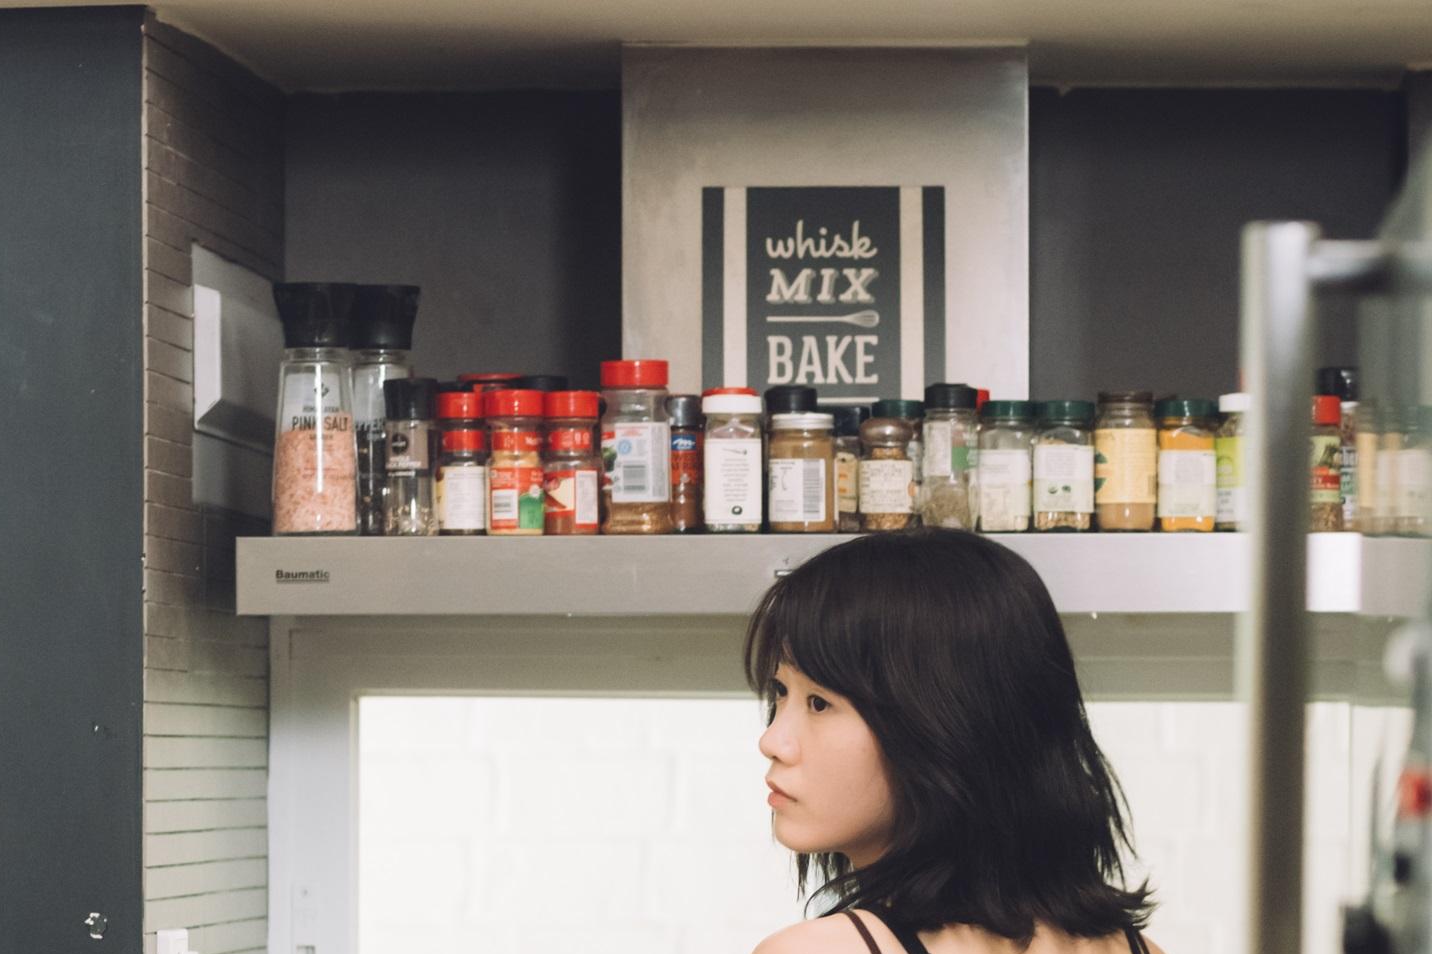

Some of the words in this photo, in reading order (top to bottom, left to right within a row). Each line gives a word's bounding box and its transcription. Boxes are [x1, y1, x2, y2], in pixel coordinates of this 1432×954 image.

[765, 219, 878, 260] whisk
[766, 267, 879, 304] MIX
[766, 334, 879, 385] BAKE
[324, 416, 349, 432] SALT
[274, 568, 330, 580] Baumatic
